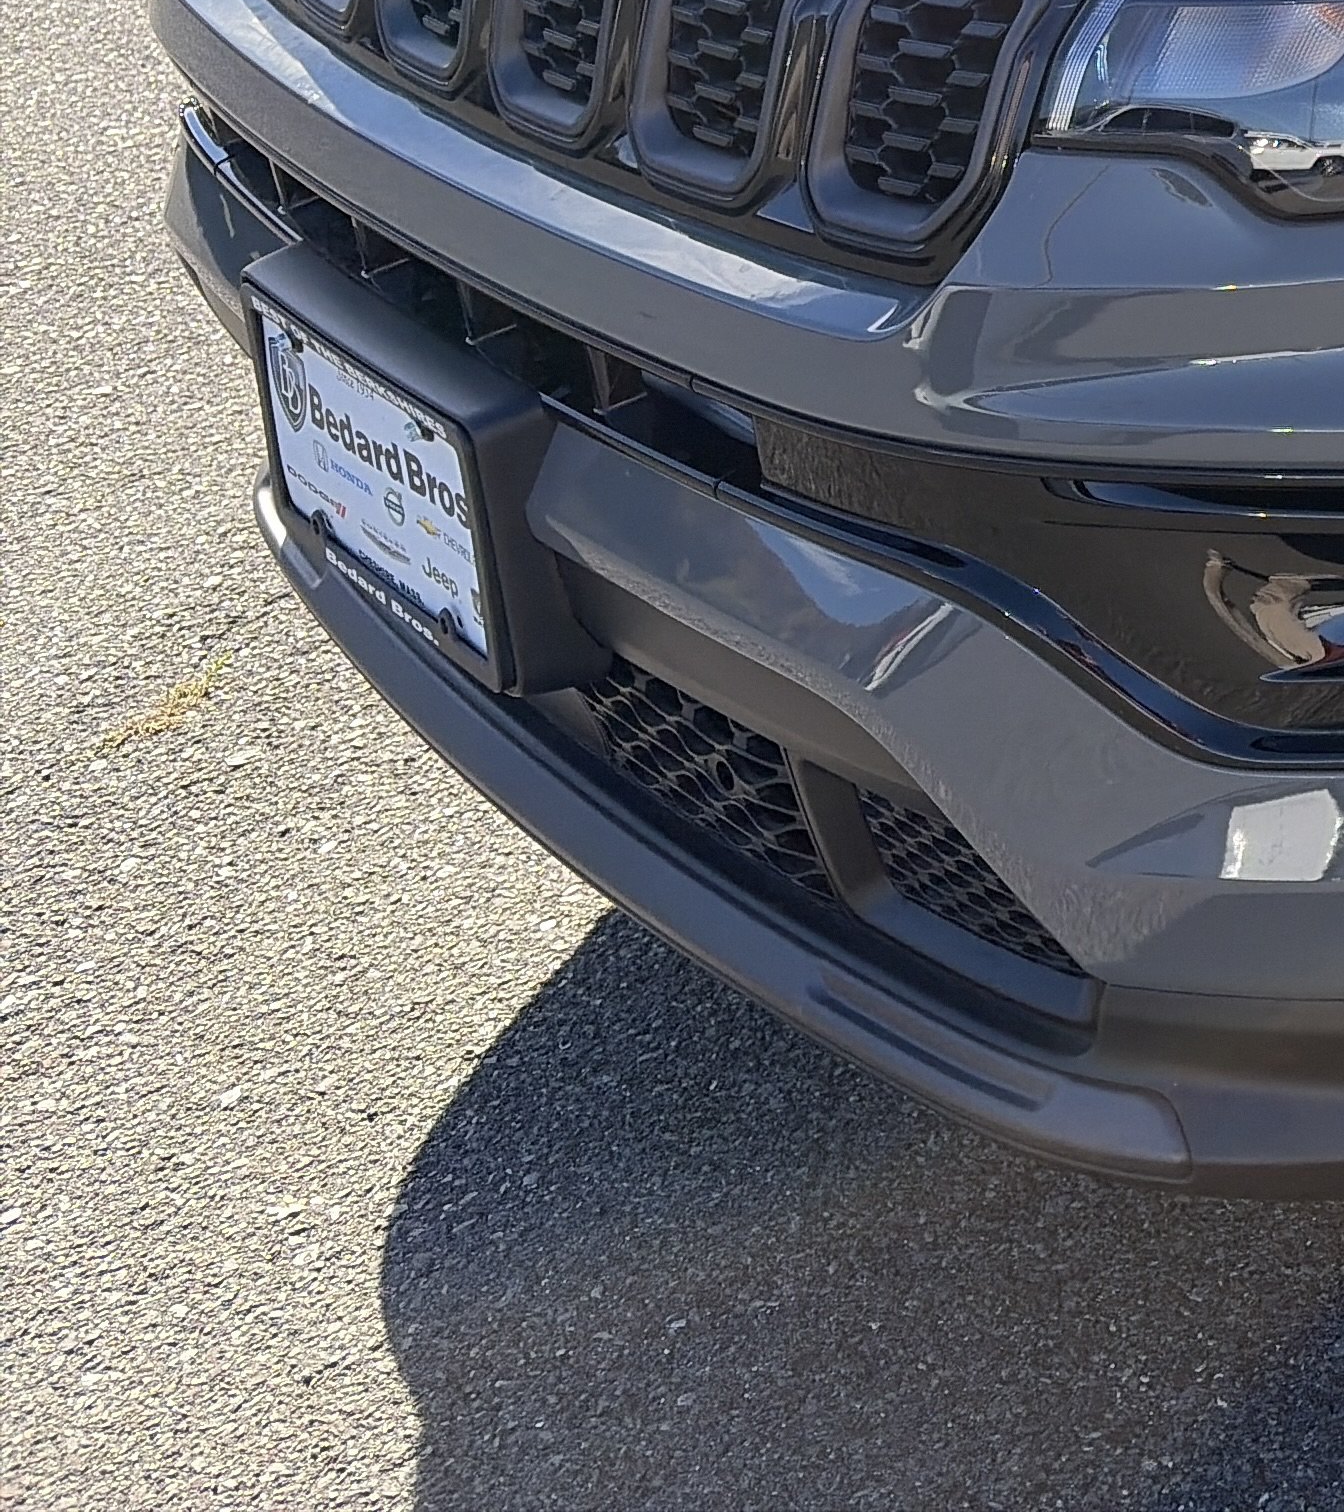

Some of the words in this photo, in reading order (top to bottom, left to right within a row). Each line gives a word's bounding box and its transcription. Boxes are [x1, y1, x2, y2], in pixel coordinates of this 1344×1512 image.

[251, 296, 288, 330] BEST
[314, 340, 344, 370] THE
[344, 363, 447, 439] BERKSHIRES
[308, 382, 404, 486] Bedard
[331, 458, 374, 497] HONDA
[325, 547, 386, 606] Bedard
[390, 599, 440, 646] Bros.
[422, 556, 459, 599] Jeep
